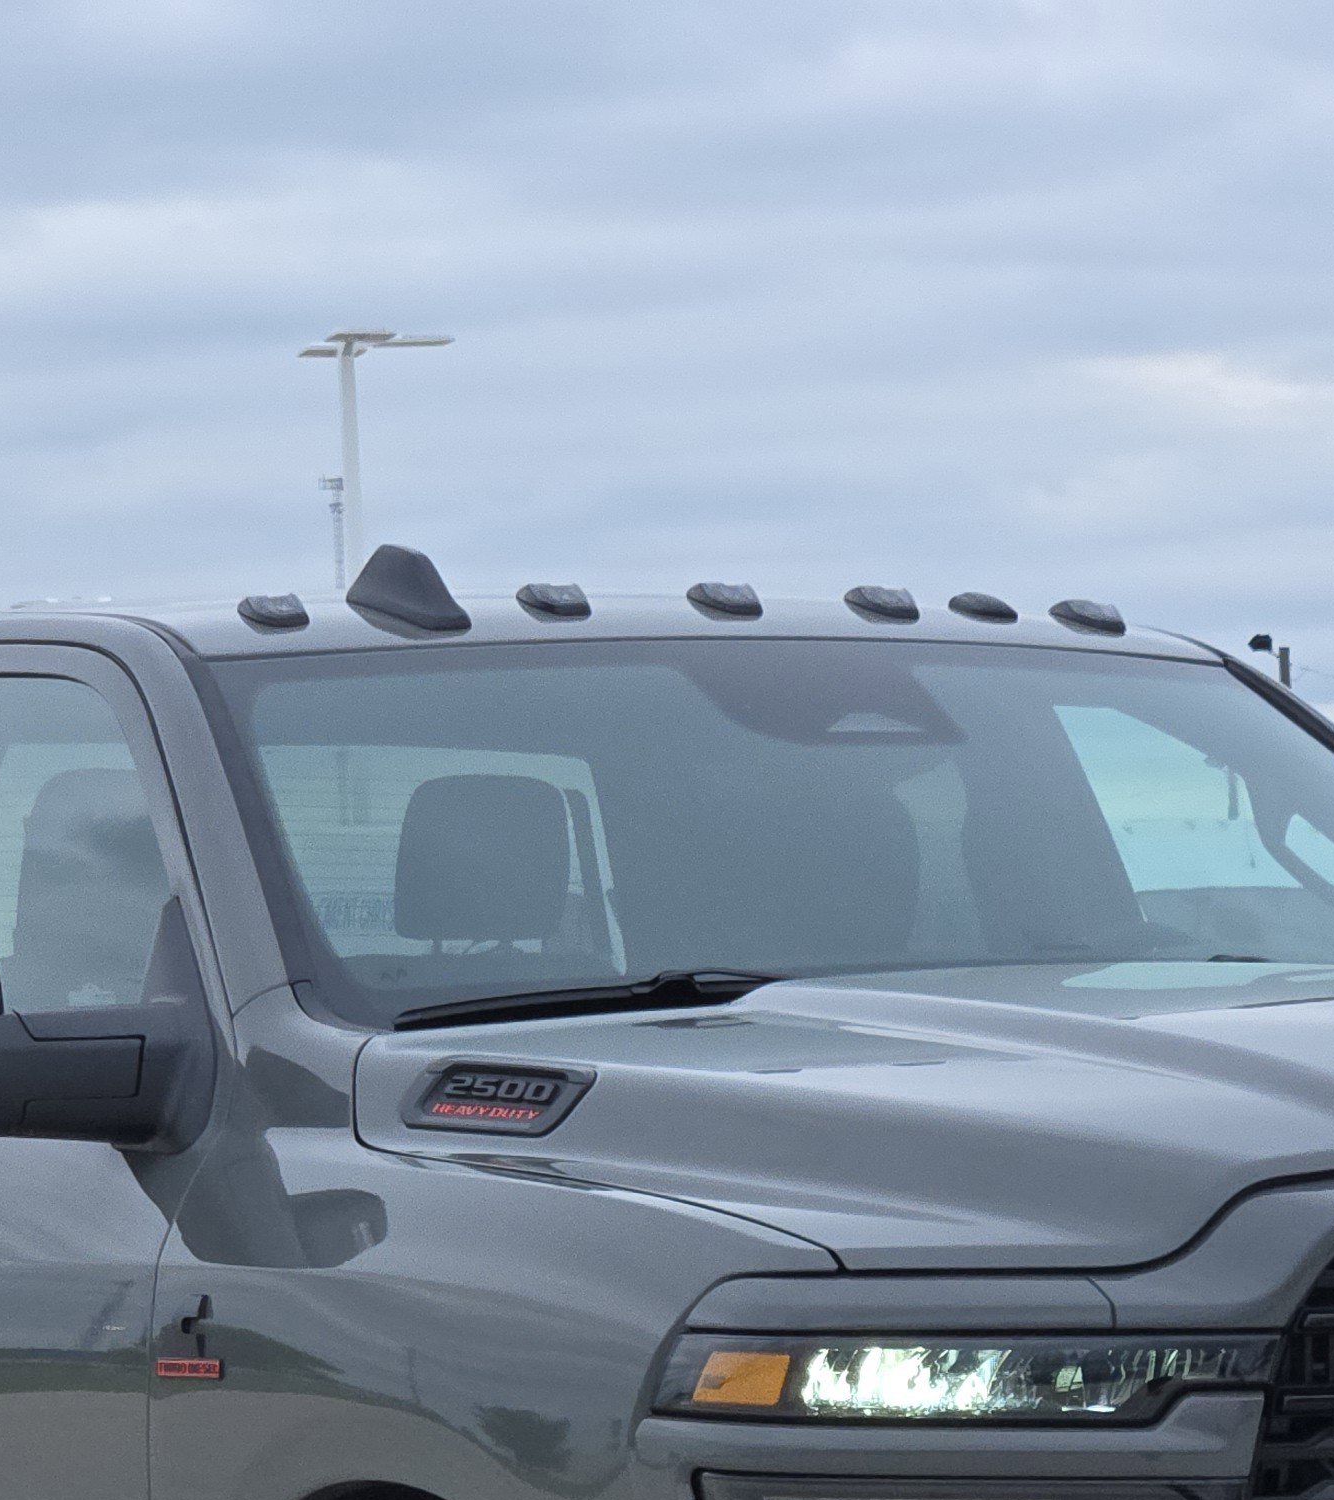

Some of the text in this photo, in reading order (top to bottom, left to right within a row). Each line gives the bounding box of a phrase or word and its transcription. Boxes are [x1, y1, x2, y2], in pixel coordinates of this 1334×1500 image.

[444, 1076, 554, 1101] 2500
[432, 1103, 541, 1120] HEAVY DUTY
